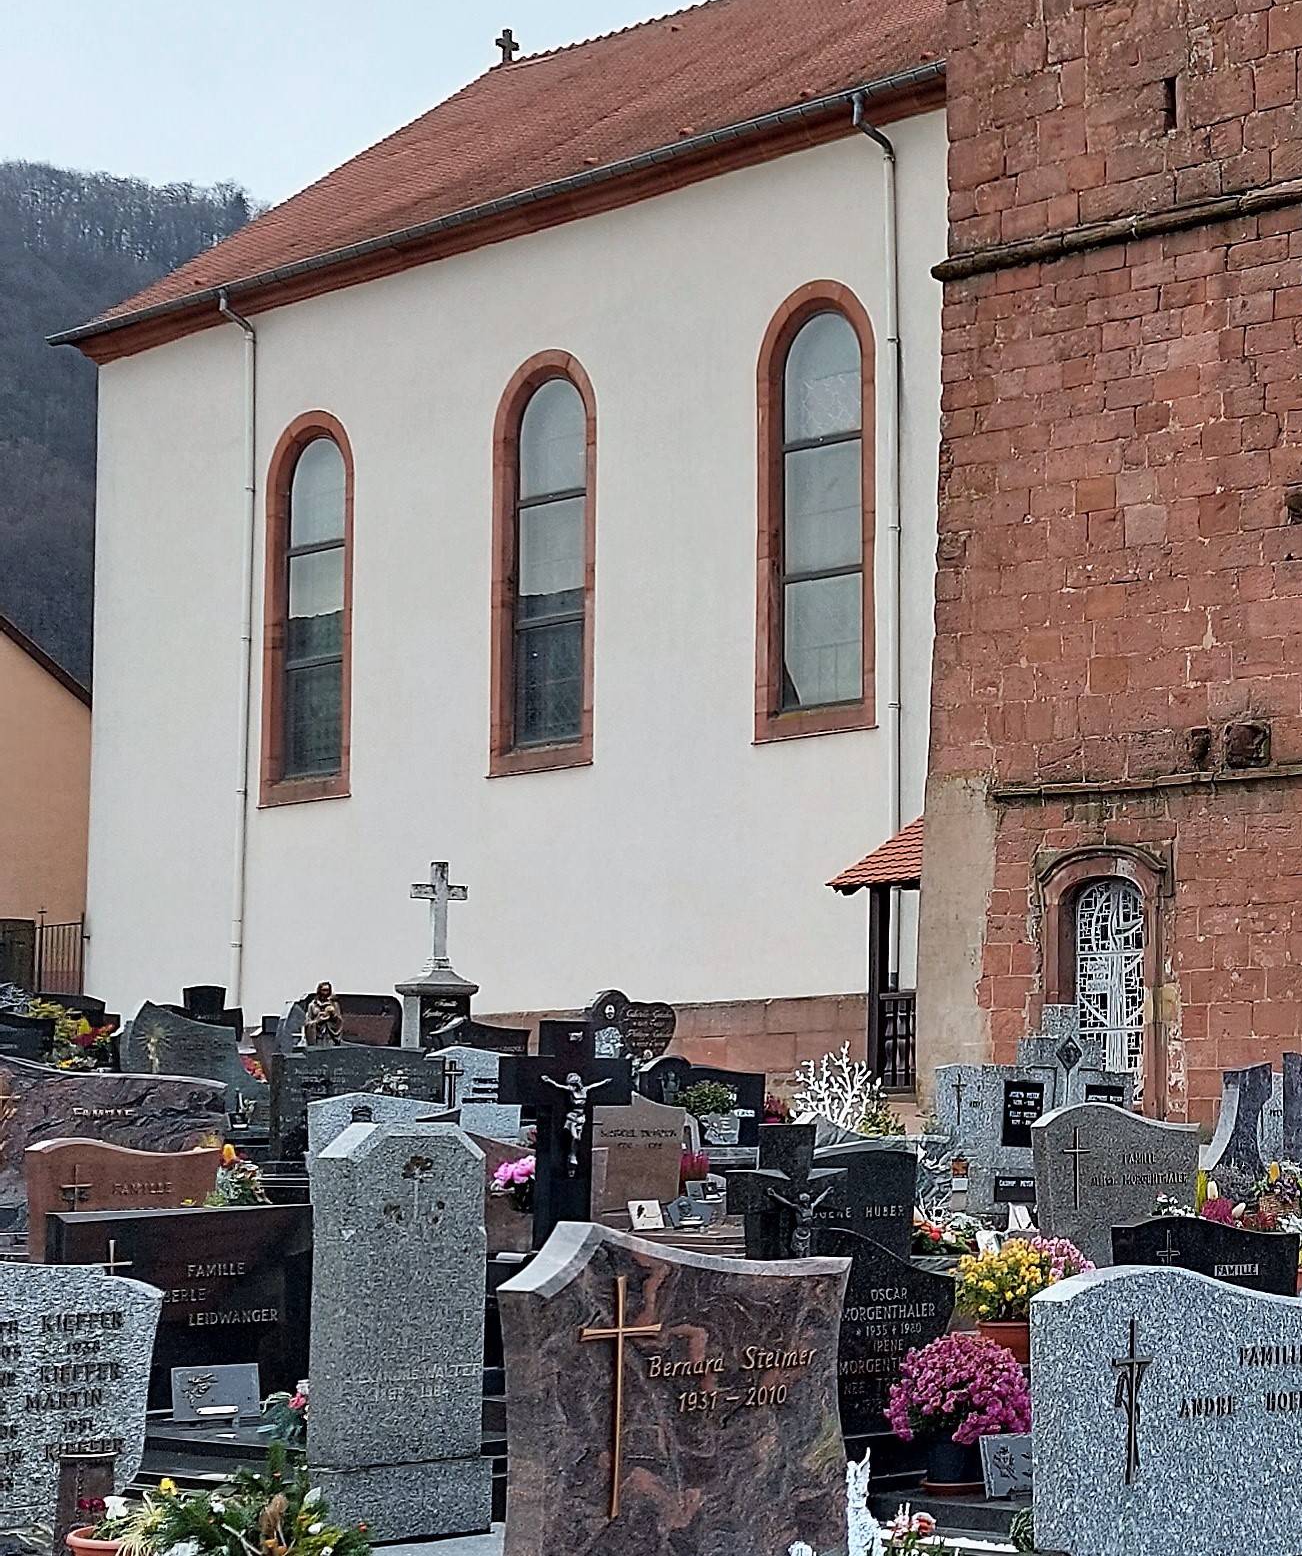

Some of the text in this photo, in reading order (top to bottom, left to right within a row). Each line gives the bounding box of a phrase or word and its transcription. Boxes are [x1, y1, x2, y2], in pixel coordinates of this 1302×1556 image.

[812, 1204, 905, 1219] UGENE HUBER
[187, 1262, 246, 1277] FAMILLE
[1214, 1263, 1260, 1277] FAMILLE
[163, 1288, 207, 1303] BERLE
[870, 1287, 908, 1302] OSCAR
[188, 1308, 279, 1327] LEIDWANGER
[841, 1302, 936, 1322] MORGENTHALER
[872, 1338, 904, 1353] IRENE
[648, 1345, 818, 1379] Bernard Steimer
[26, 1387, 103, 1413] MARTIN
[678, 1391, 719, 1413] 1931
[745, 1384, 788, 1407] 2010
